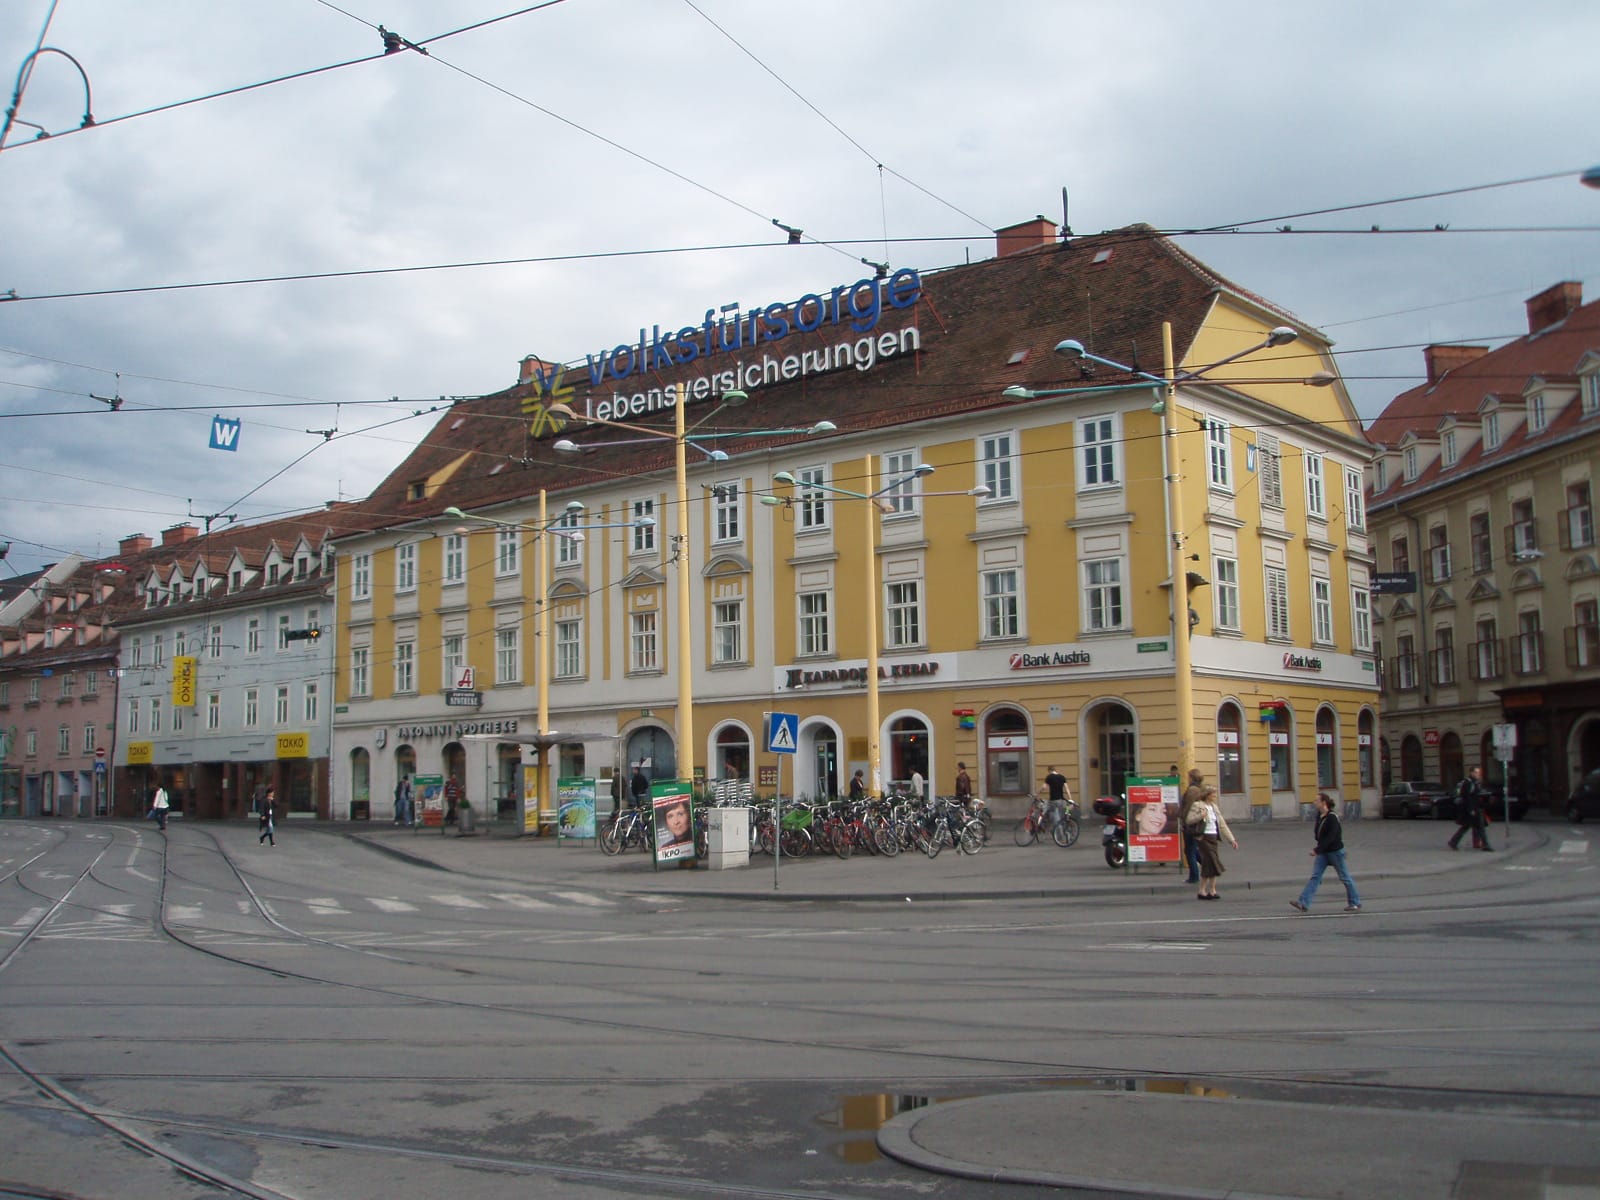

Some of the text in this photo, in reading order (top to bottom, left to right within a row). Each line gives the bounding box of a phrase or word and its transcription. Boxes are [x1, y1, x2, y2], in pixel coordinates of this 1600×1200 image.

[215, 422, 238, 446] W
[1023, 650, 1091, 667] Bank Austria
[1290, 654, 1304, 667] Bank
[458, 668, 472, 687] A
[804, 667, 887, 684] KAPADOKA
[456, 720, 518, 738] APOTHEKE
